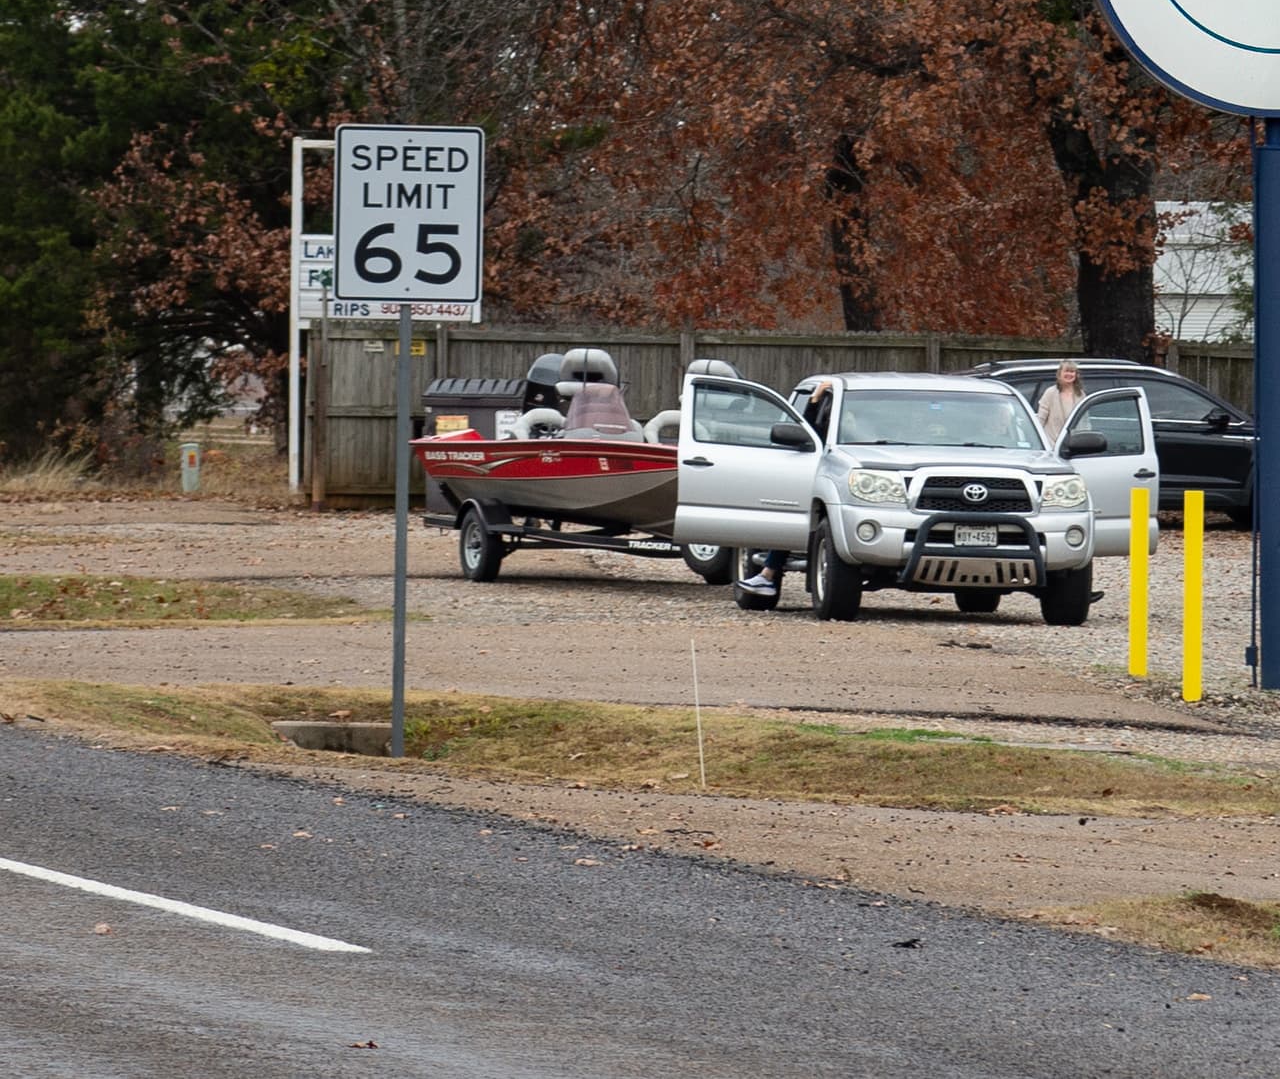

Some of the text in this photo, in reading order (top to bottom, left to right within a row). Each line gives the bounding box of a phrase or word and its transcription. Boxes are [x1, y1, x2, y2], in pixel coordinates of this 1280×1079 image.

[351, 144, 469, 173] SPEED
[363, 182, 455, 209] LIMIT
[303, 240, 334, 259] LAK
[354, 222, 462, 285] 65
[628, 540, 672, 551] TRACKER
